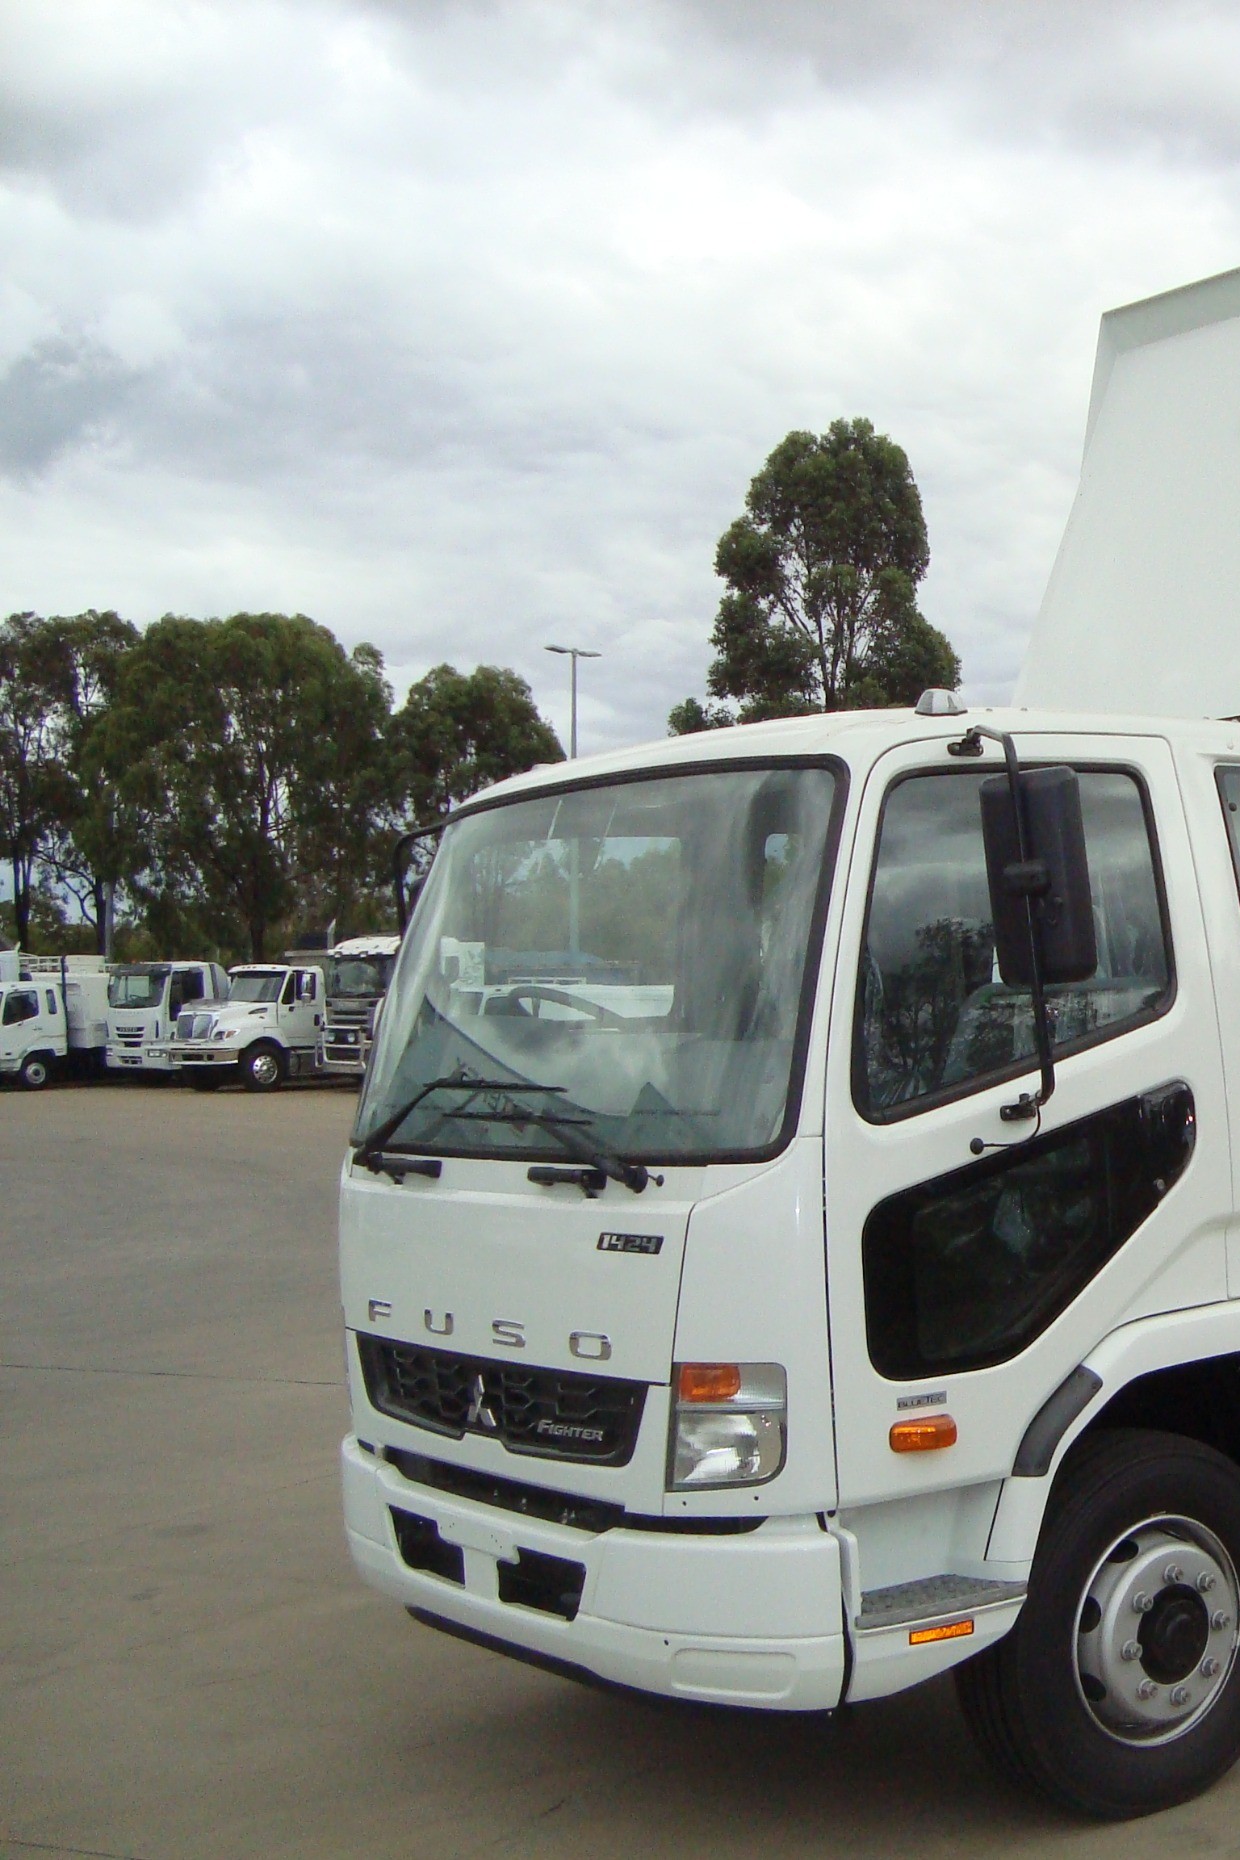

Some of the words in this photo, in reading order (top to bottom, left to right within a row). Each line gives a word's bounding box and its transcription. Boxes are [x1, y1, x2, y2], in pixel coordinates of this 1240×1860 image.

[601, 1234, 658, 1253] 1424
[368, 1297, 613, 1361] FUSO
[536, 1419, 604, 1442] FIGHTER
